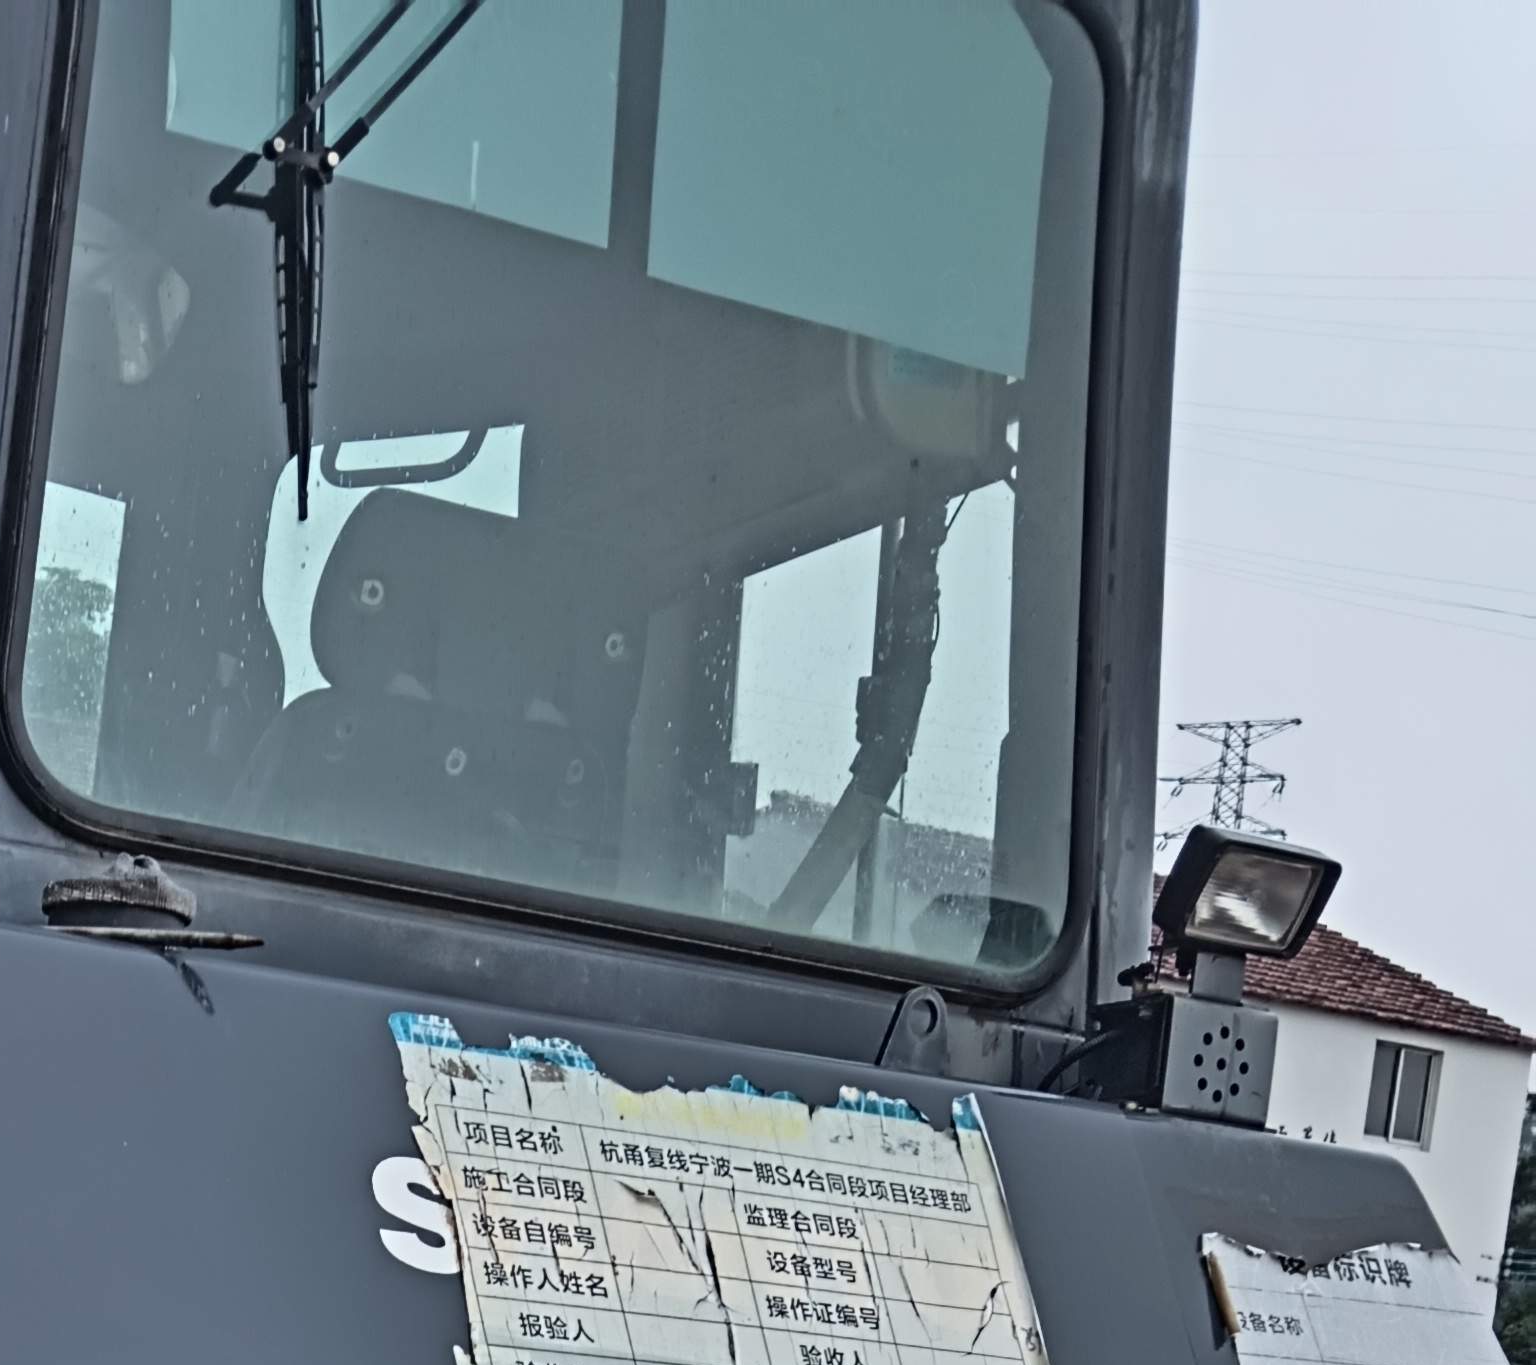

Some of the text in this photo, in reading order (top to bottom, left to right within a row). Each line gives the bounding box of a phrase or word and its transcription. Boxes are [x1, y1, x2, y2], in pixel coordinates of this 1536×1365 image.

[464, 1122, 563, 1155] 项目名称
[462, 1166, 587, 1204] 施工合同段
[600, 1140, 972, 1213] 杭甬复线宁波一期S4合同段项目经理部
[472, 1213, 596, 1251] 设备自编号
[744, 1204, 859, 1240] 监理合同段
[484, 1261, 608, 1298] 操作人姓名
[766, 1250, 857, 1283] 设备型号
[519, 1313, 595, 1343] 报验人
[766, 1295, 880, 1330] 操作证编号
